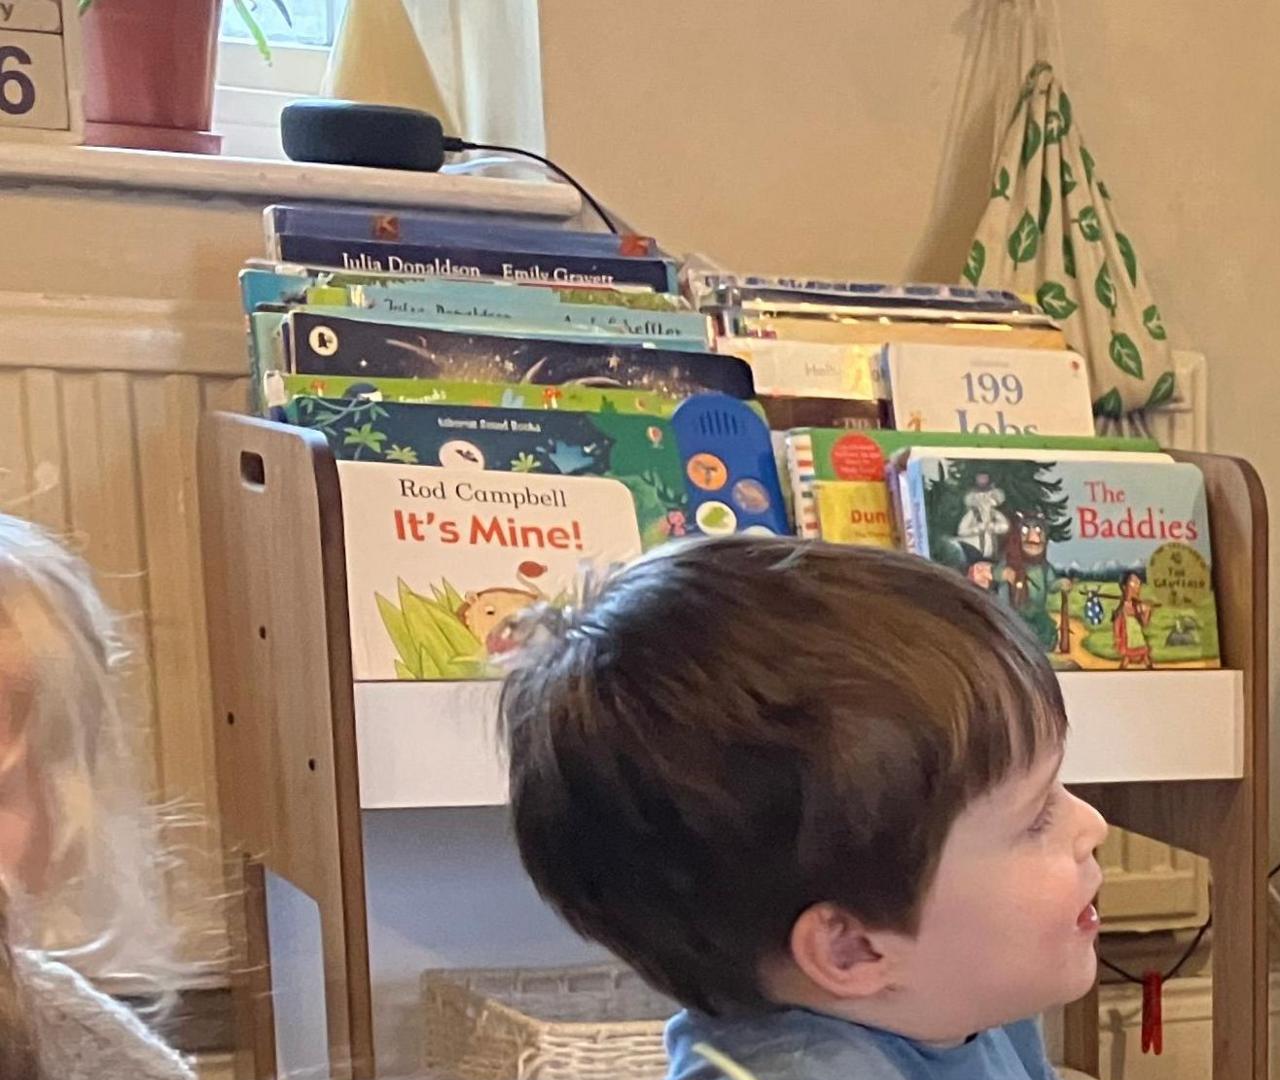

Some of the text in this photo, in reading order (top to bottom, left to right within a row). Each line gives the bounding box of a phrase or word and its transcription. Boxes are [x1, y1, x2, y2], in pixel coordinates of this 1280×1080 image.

[342, 252, 480, 276] Julia Donaldson
[502, 263, 549, 281] Emily
[961, 372, 1024, 405] 199
[399, 478, 567, 510] Rod Campbell
[1083, 480, 1127, 503] The
[394, 509, 584, 550] It's Mine!
[1076, 506, 1199, 540] Baddies
